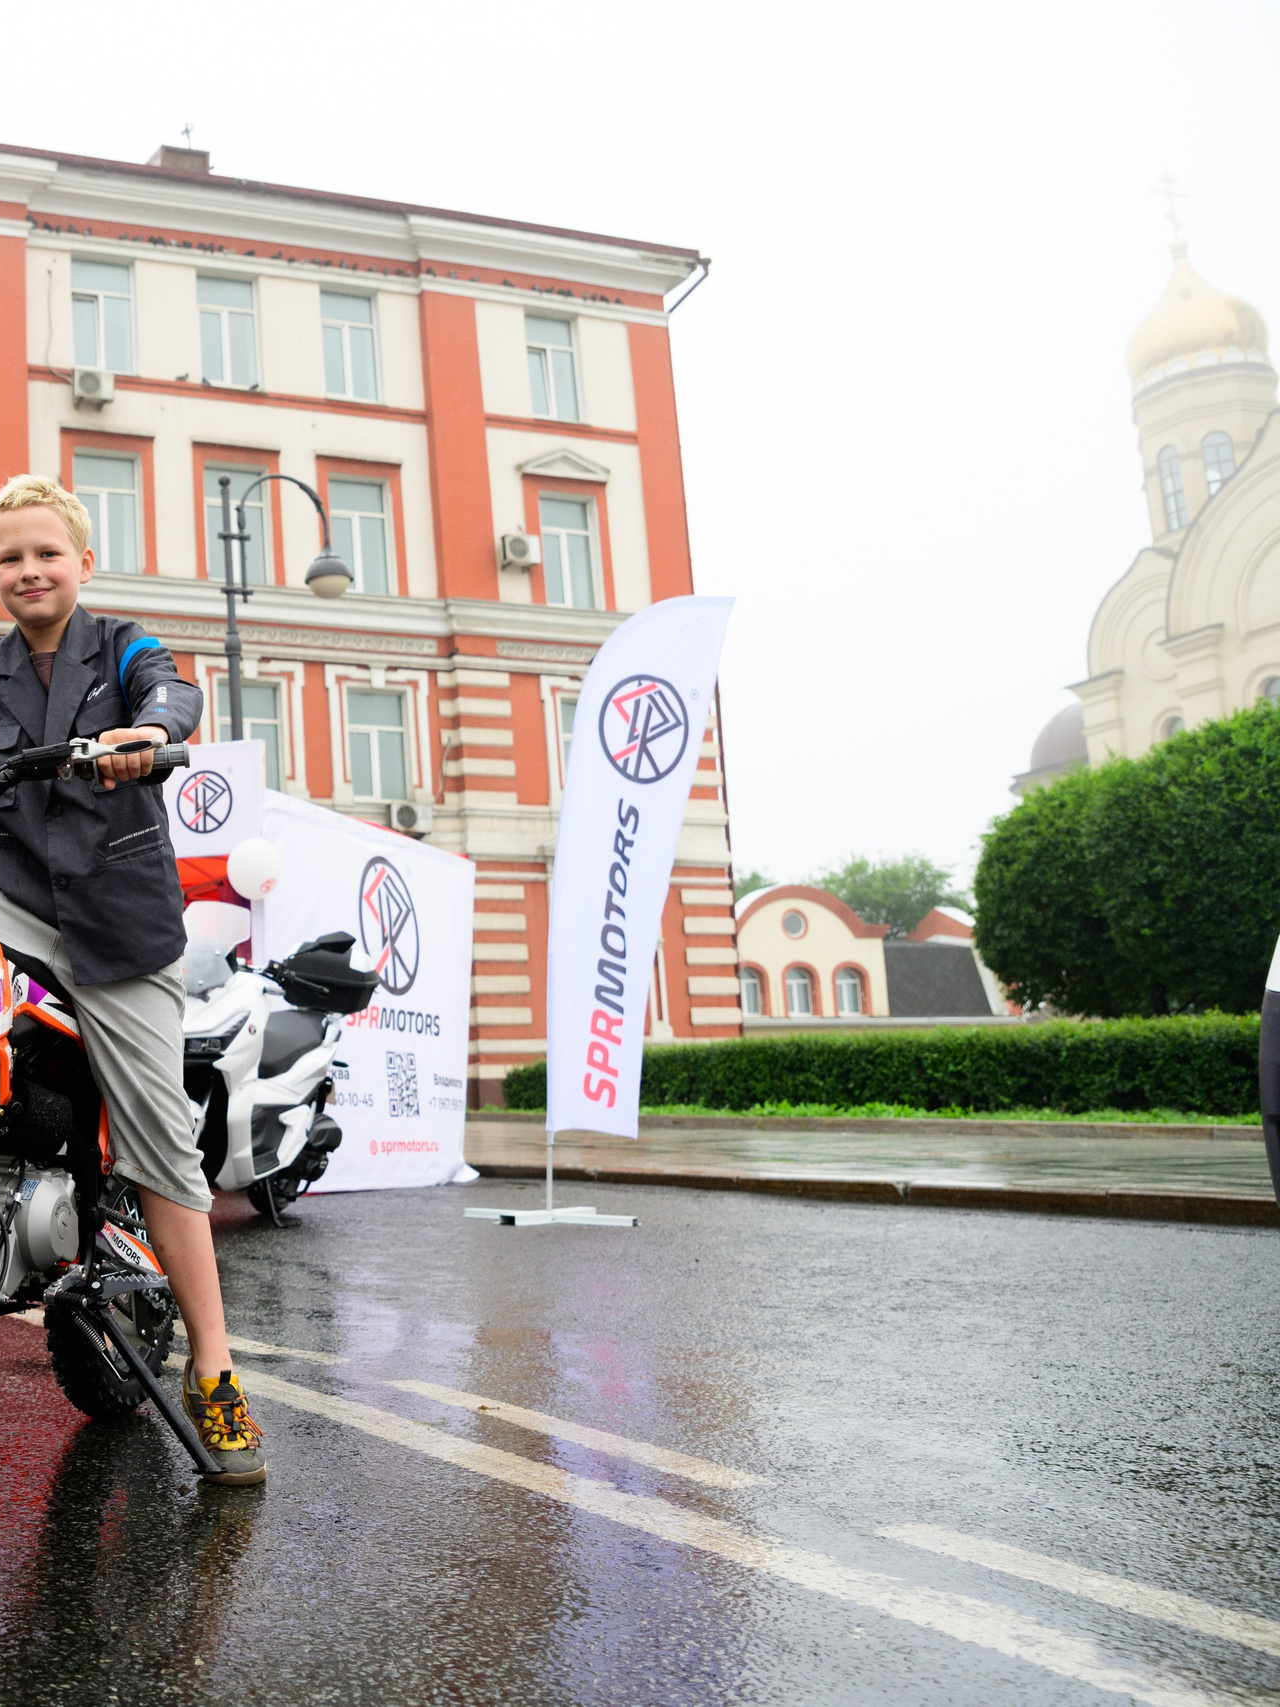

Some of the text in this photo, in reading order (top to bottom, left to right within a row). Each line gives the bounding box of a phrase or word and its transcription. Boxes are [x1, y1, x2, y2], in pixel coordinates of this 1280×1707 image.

[583, 798, 640, 1109] SPRMOTORS
[328, 1069, 350, 1080] ква
[335, 1092, 374, 1107] 0-10-45
[381, 1139, 439, 1157] sprmotors.ru
[103, 1220, 141, 1265] SPRMOTORS
